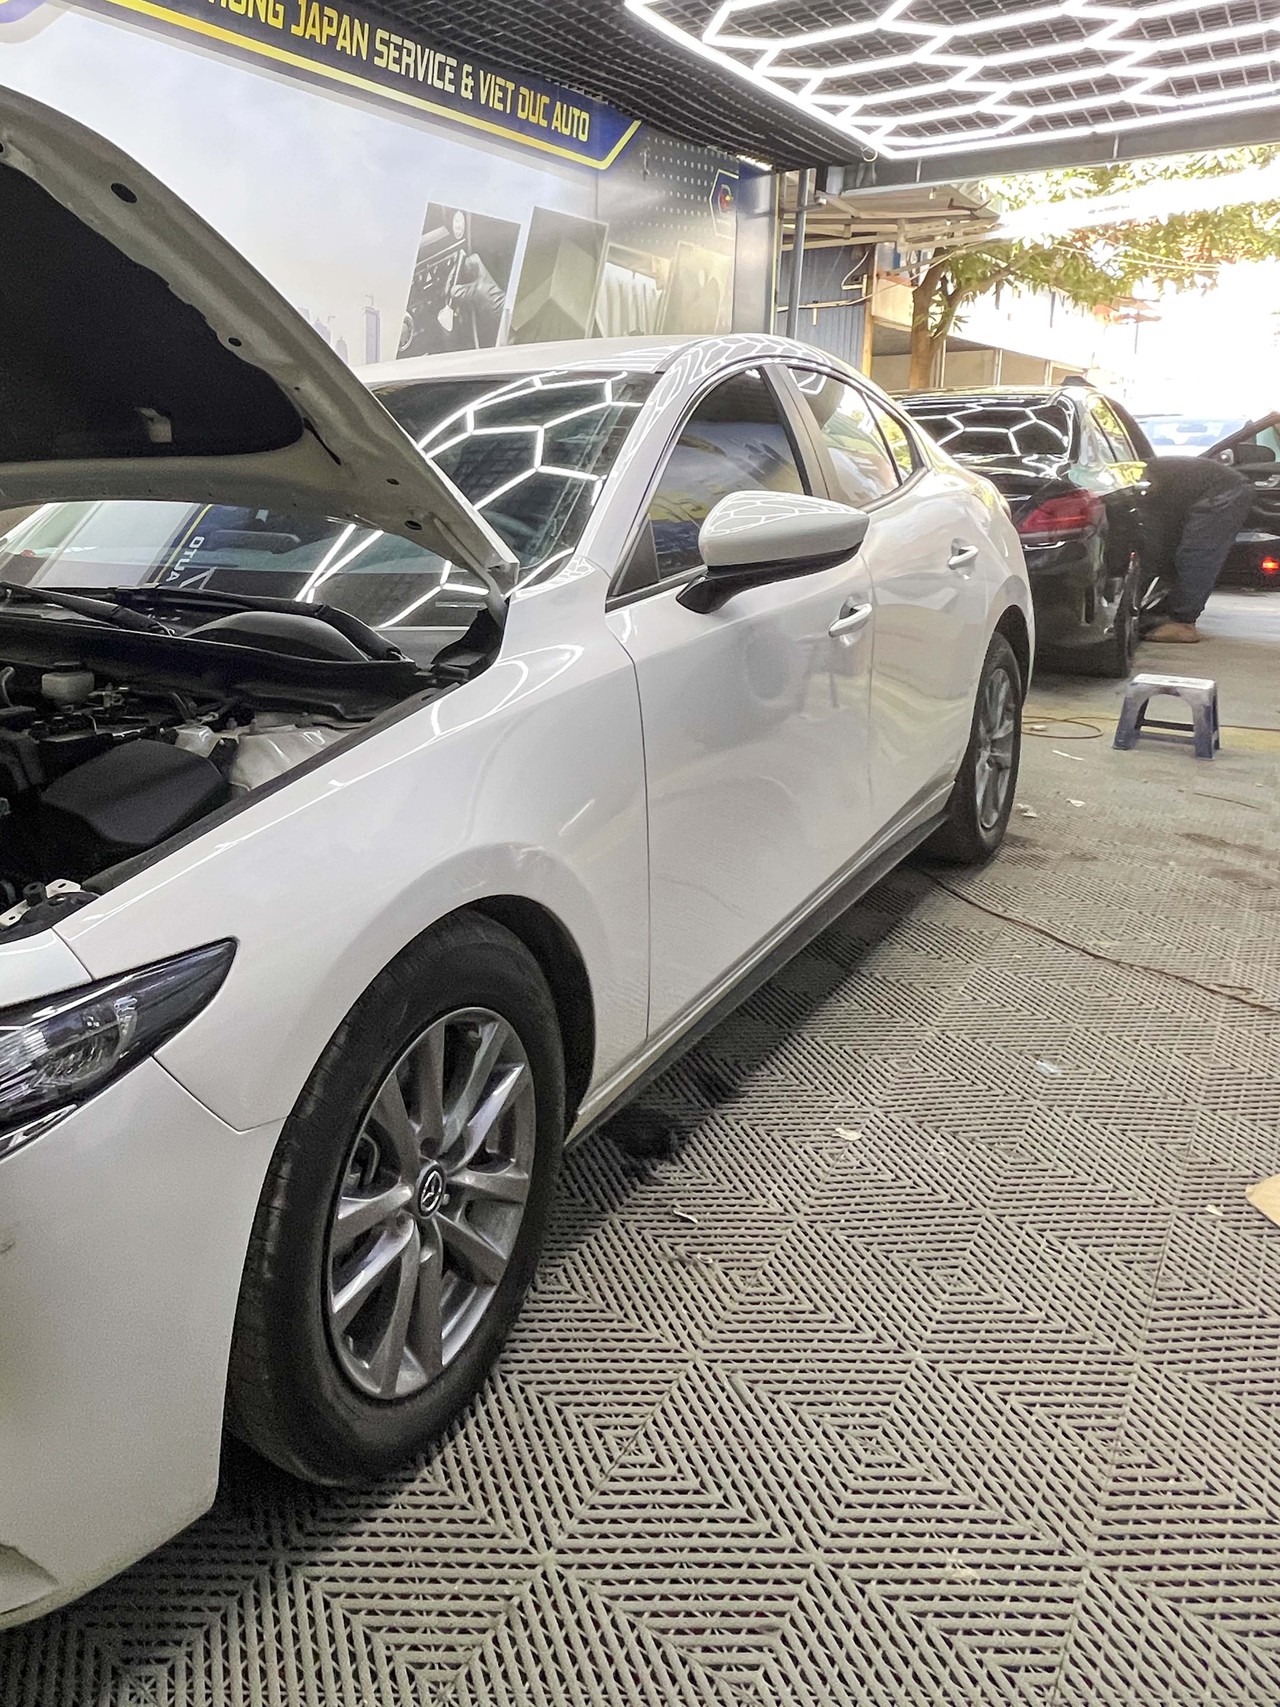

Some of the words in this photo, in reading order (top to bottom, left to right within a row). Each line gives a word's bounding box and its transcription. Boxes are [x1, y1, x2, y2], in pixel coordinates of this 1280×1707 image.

[290, 0, 370, 61] JAPAN
[373, 28, 458, 94] SERVICE
[460, 63, 475, 100] &
[479, 69, 516, 114] VIET
[517, 86, 551, 128] DUC
[551, 101, 590, 143] AUTO
